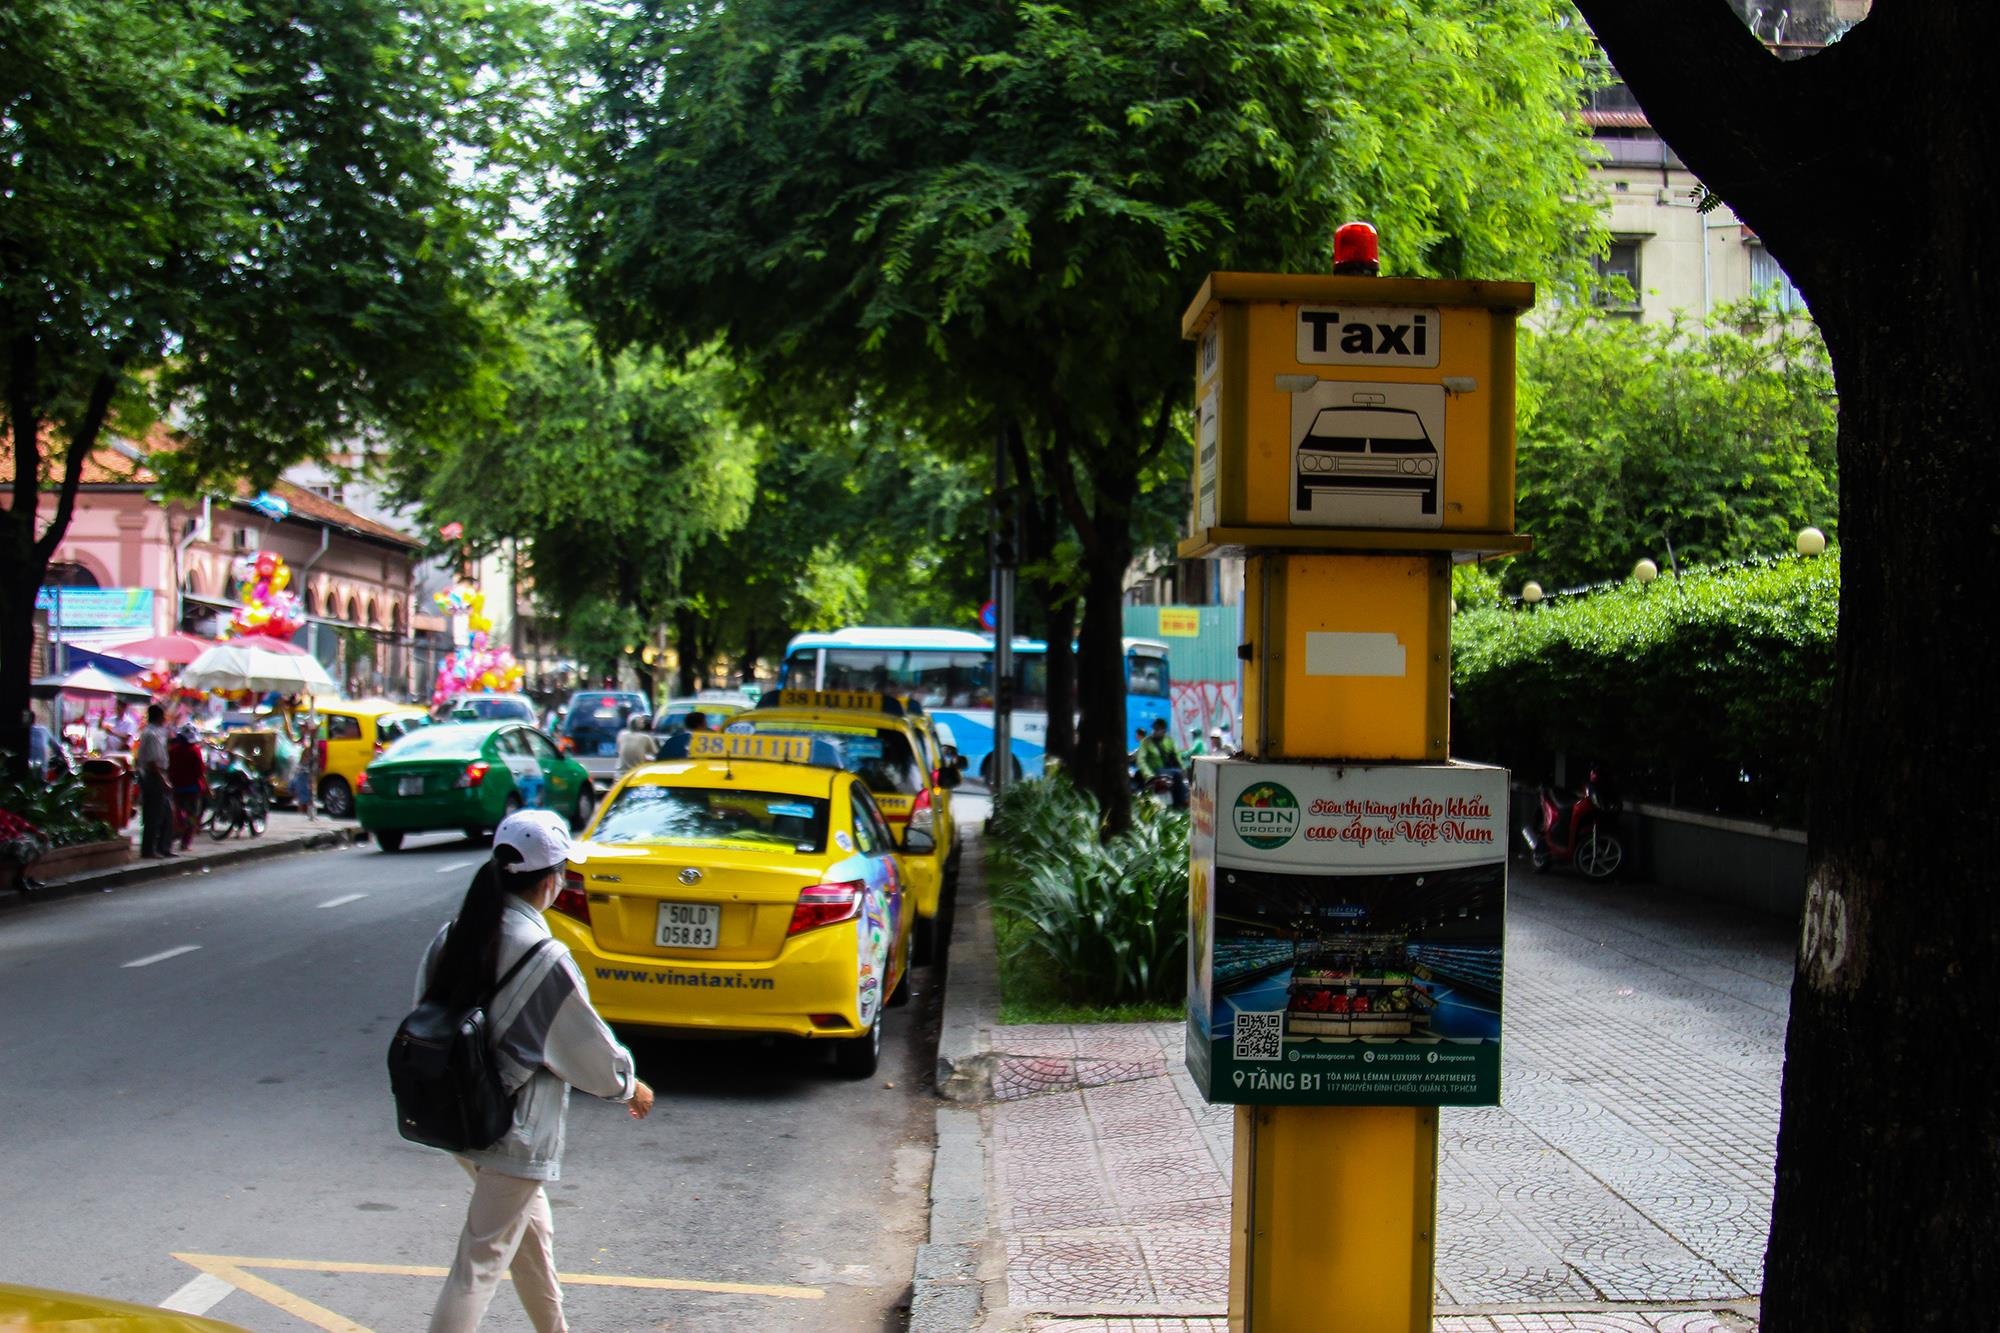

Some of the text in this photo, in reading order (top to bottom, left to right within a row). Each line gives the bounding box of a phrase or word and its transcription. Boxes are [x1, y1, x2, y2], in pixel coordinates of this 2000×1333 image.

[1301, 311, 1427, 356] Taxi
[786, 691, 808, 705] 38
[695, 736, 803, 758] 38 111 111
[1240, 810, 1293, 824] BON
[1310, 799, 1343, 815] Siêu
[1365, 800, 1398, 821] hàng
[1399, 796, 1443, 821] nhập
[1446, 794, 1491, 818] khẩu
[1239, 826, 1292, 834] GROCER
[1306, 815, 1494, 847] cao cấp tại Việt Nam
[669, 905, 708, 925] 50LD
[661, 926, 713, 946] 058.83
[594, 966, 775, 990] www.vinataxi.vn
[1247, 1066, 1321, 1091] TẦNG B1
[1391, 1073, 1423, 1082] LUXURY
[1425, 1073, 1477, 1082] APARTMENTS
